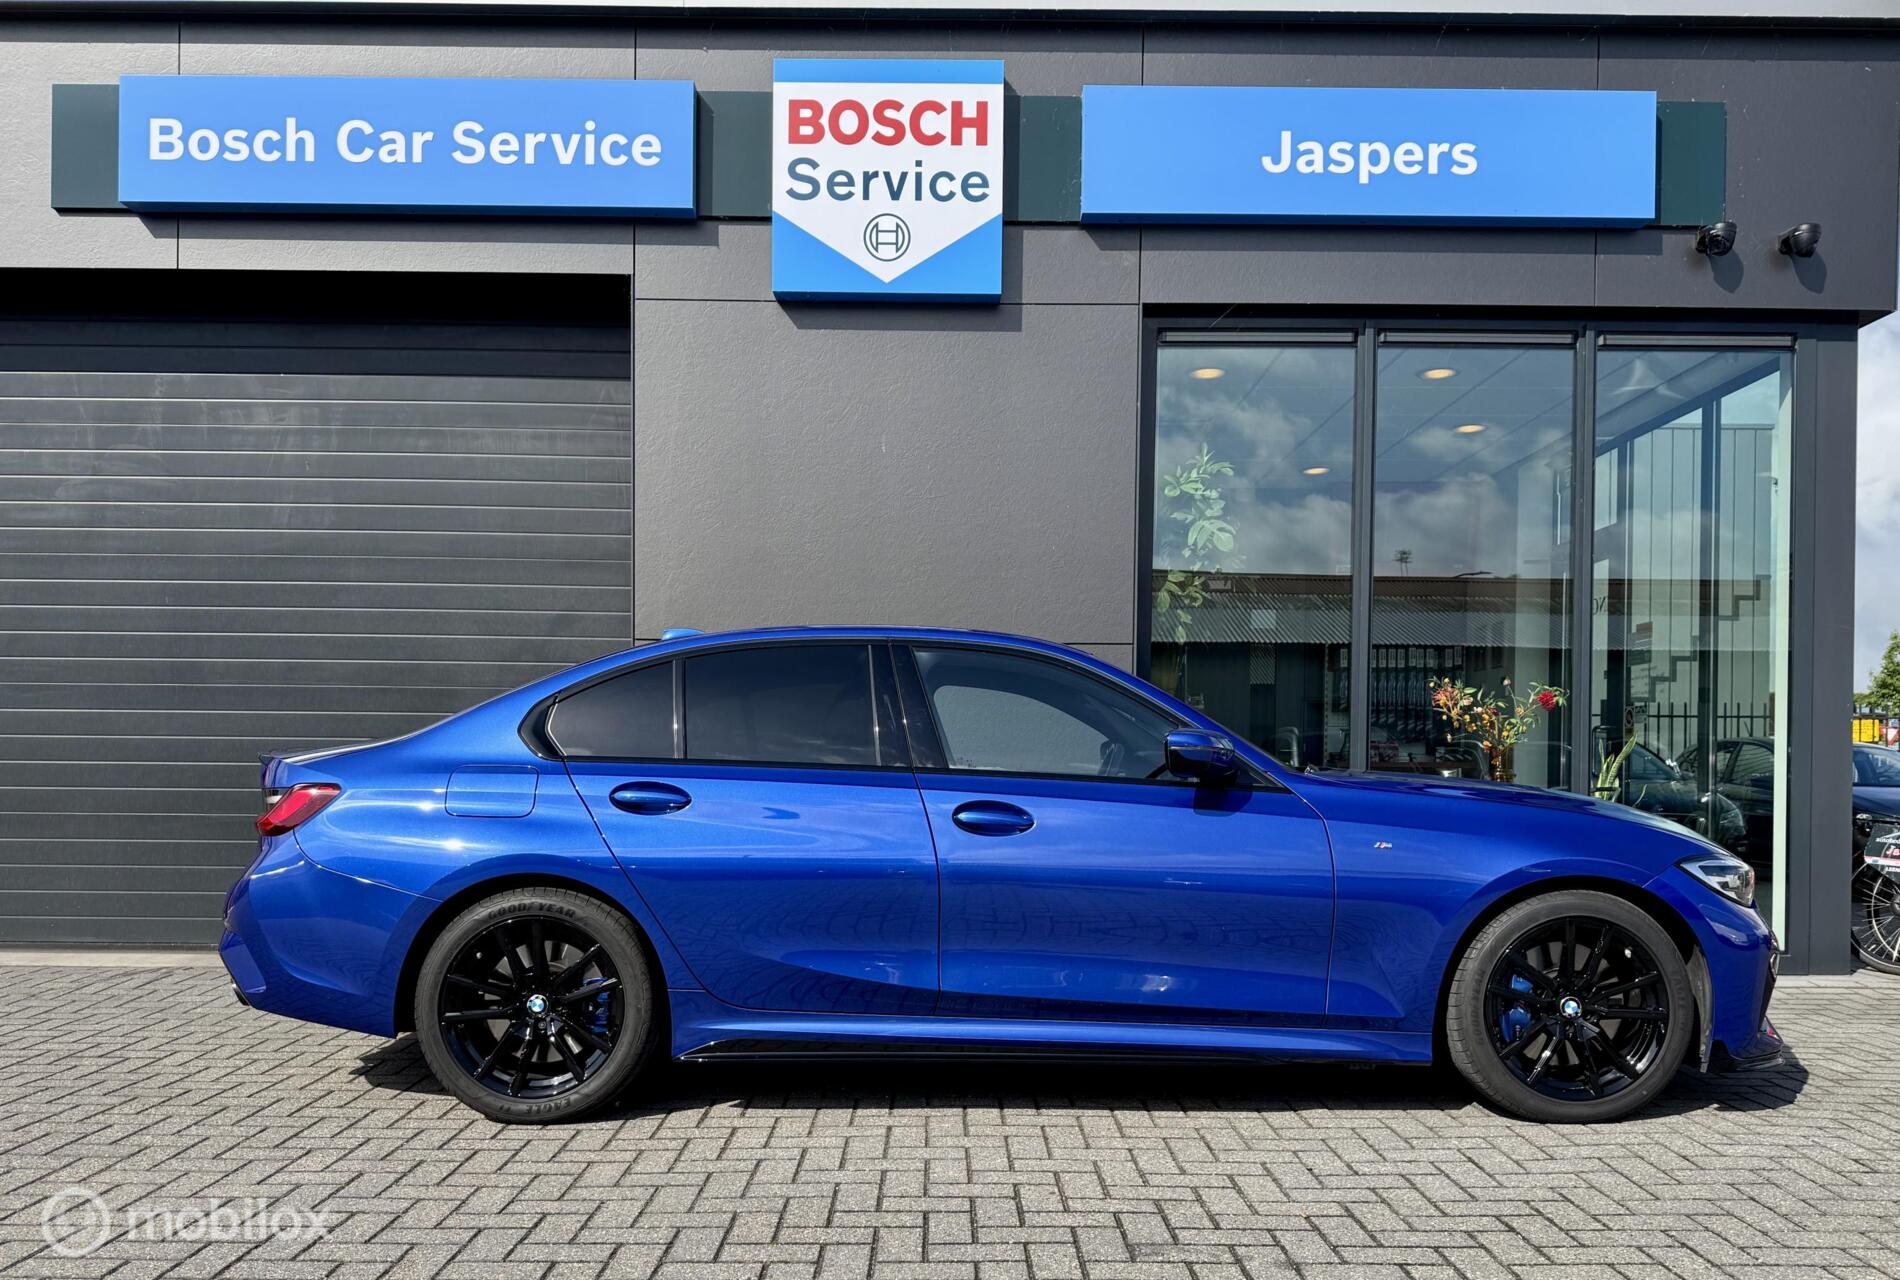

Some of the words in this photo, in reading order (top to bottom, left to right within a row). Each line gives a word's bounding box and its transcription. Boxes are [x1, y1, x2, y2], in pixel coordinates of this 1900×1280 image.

[149, 117, 315, 162] Bosch
[336, 119, 434, 163] Car
[451, 120, 662, 166] Service
[788, 98, 989, 147] BOSCH
[786, 157, 990, 203] Service
[1261, 130, 1478, 184] Jaspers
